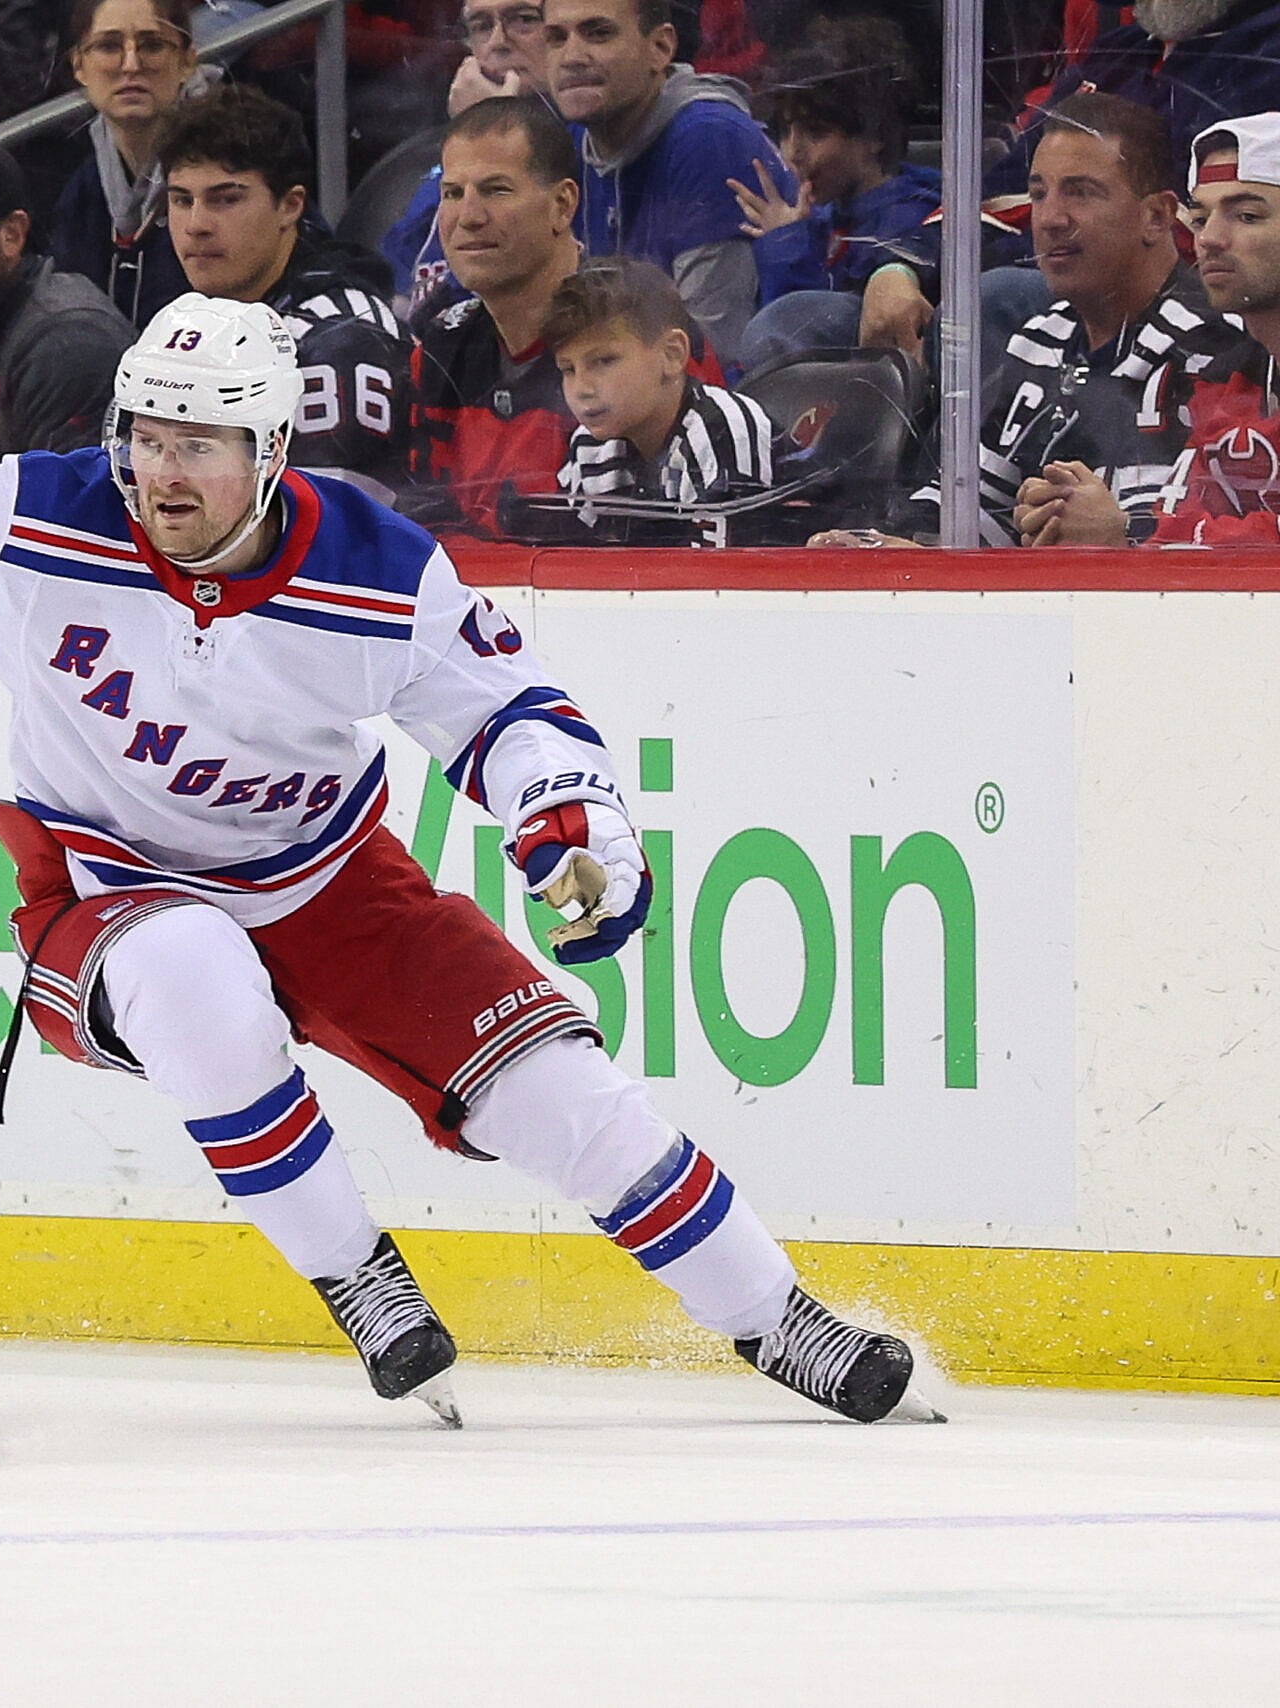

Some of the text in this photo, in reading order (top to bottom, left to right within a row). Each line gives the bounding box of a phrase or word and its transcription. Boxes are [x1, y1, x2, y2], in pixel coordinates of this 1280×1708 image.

[164, 328, 202, 351] 13
[144, 376, 195, 391] BAUER
[294, 363, 393, 434] 86
[999, 381, 1044, 446] C
[49, 624, 342, 827] RANGERS
[518, 771, 627, 816] BAU
